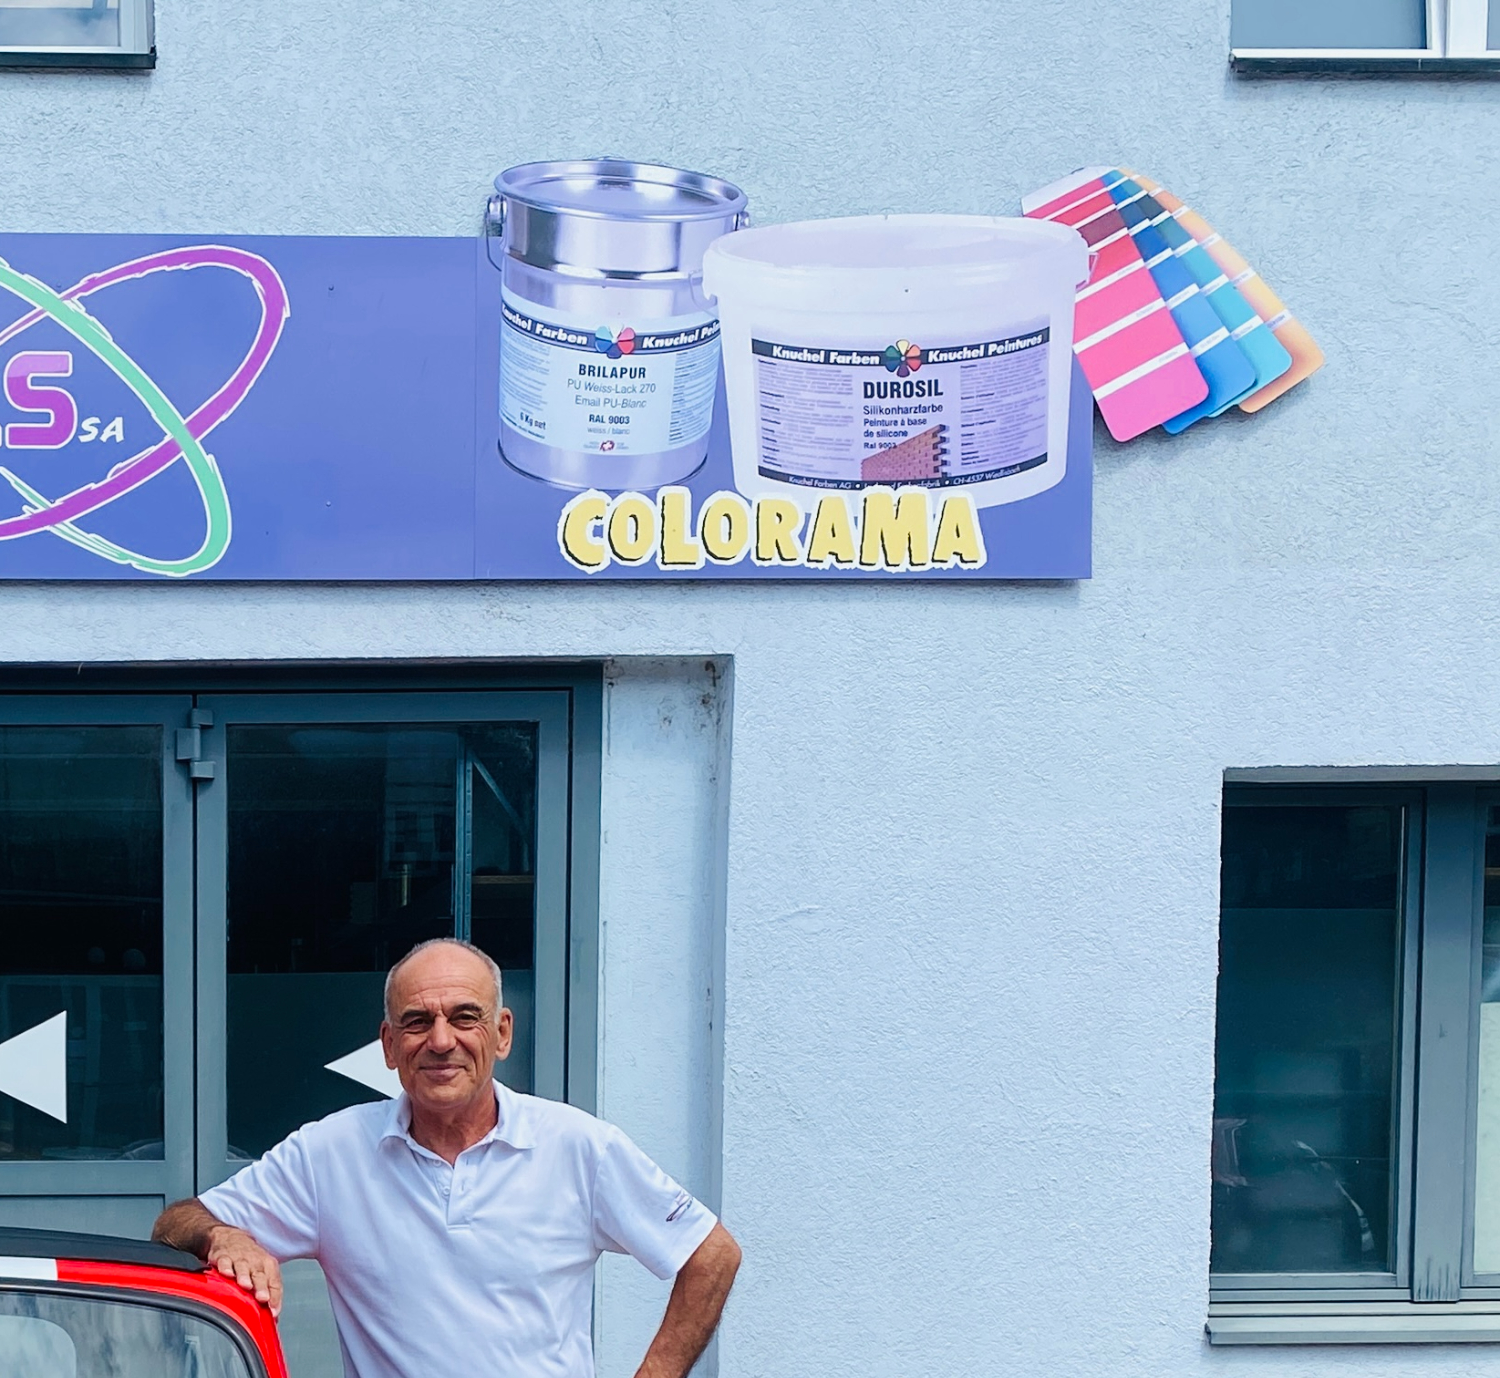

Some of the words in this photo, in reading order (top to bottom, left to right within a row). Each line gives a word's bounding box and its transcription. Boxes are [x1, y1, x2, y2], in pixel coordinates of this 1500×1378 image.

[535, 322, 588, 346] Farben
[642, 329, 699, 349] Knuchel
[772, 345, 825, 363] Knuchel
[828, 348, 880, 366] Farben
[927, 346, 985, 363] Knuchel
[987, 332, 1043, 357] Peintures
[578, 363, 647, 379] BRILAPUR
[567, 378, 582, 390] PU
[584, 381, 638, 394] Weiss-Lack
[639, 383, 657, 394] 270
[862, 378, 944, 399] DUROSIL
[863, 403, 944, 416] Silikonharzfarbe
[588, 413, 607, 424] RAL
[608, 415, 631, 425] 9003
[863, 418, 899, 428] Peinture
[907, 417, 928, 427] base
[78, 416, 125, 443] SA
[863, 428, 875, 438] de
[876, 428, 909, 438] silicone
[560, 488, 982, 571] COLORAMA
